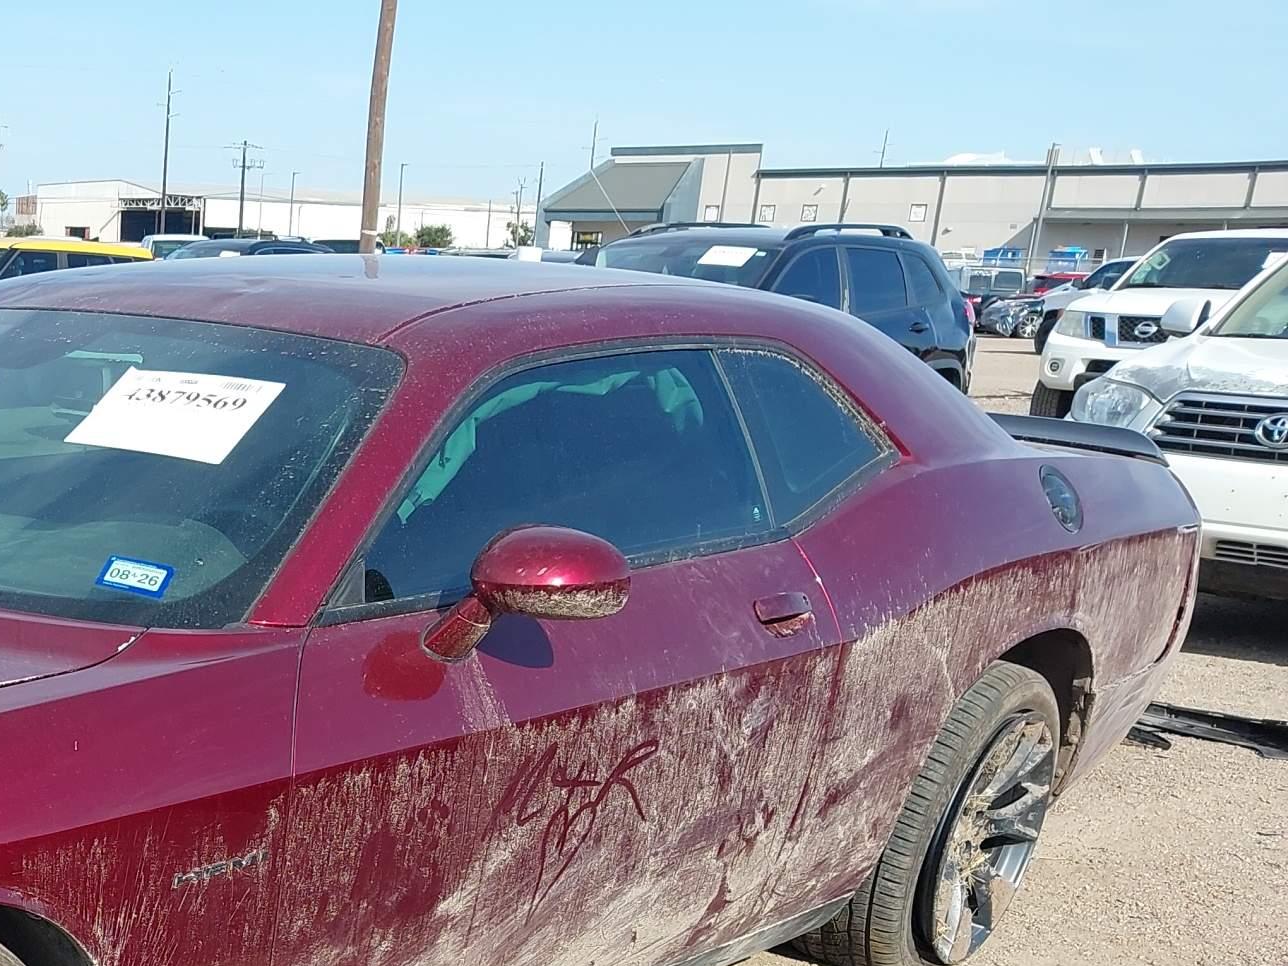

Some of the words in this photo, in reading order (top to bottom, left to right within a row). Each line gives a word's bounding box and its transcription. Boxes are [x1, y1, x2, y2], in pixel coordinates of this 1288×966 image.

[121, 387, 248, 411] 43879569
[109, 567, 131, 581] 08
[136, 573, 160, 587] 26
